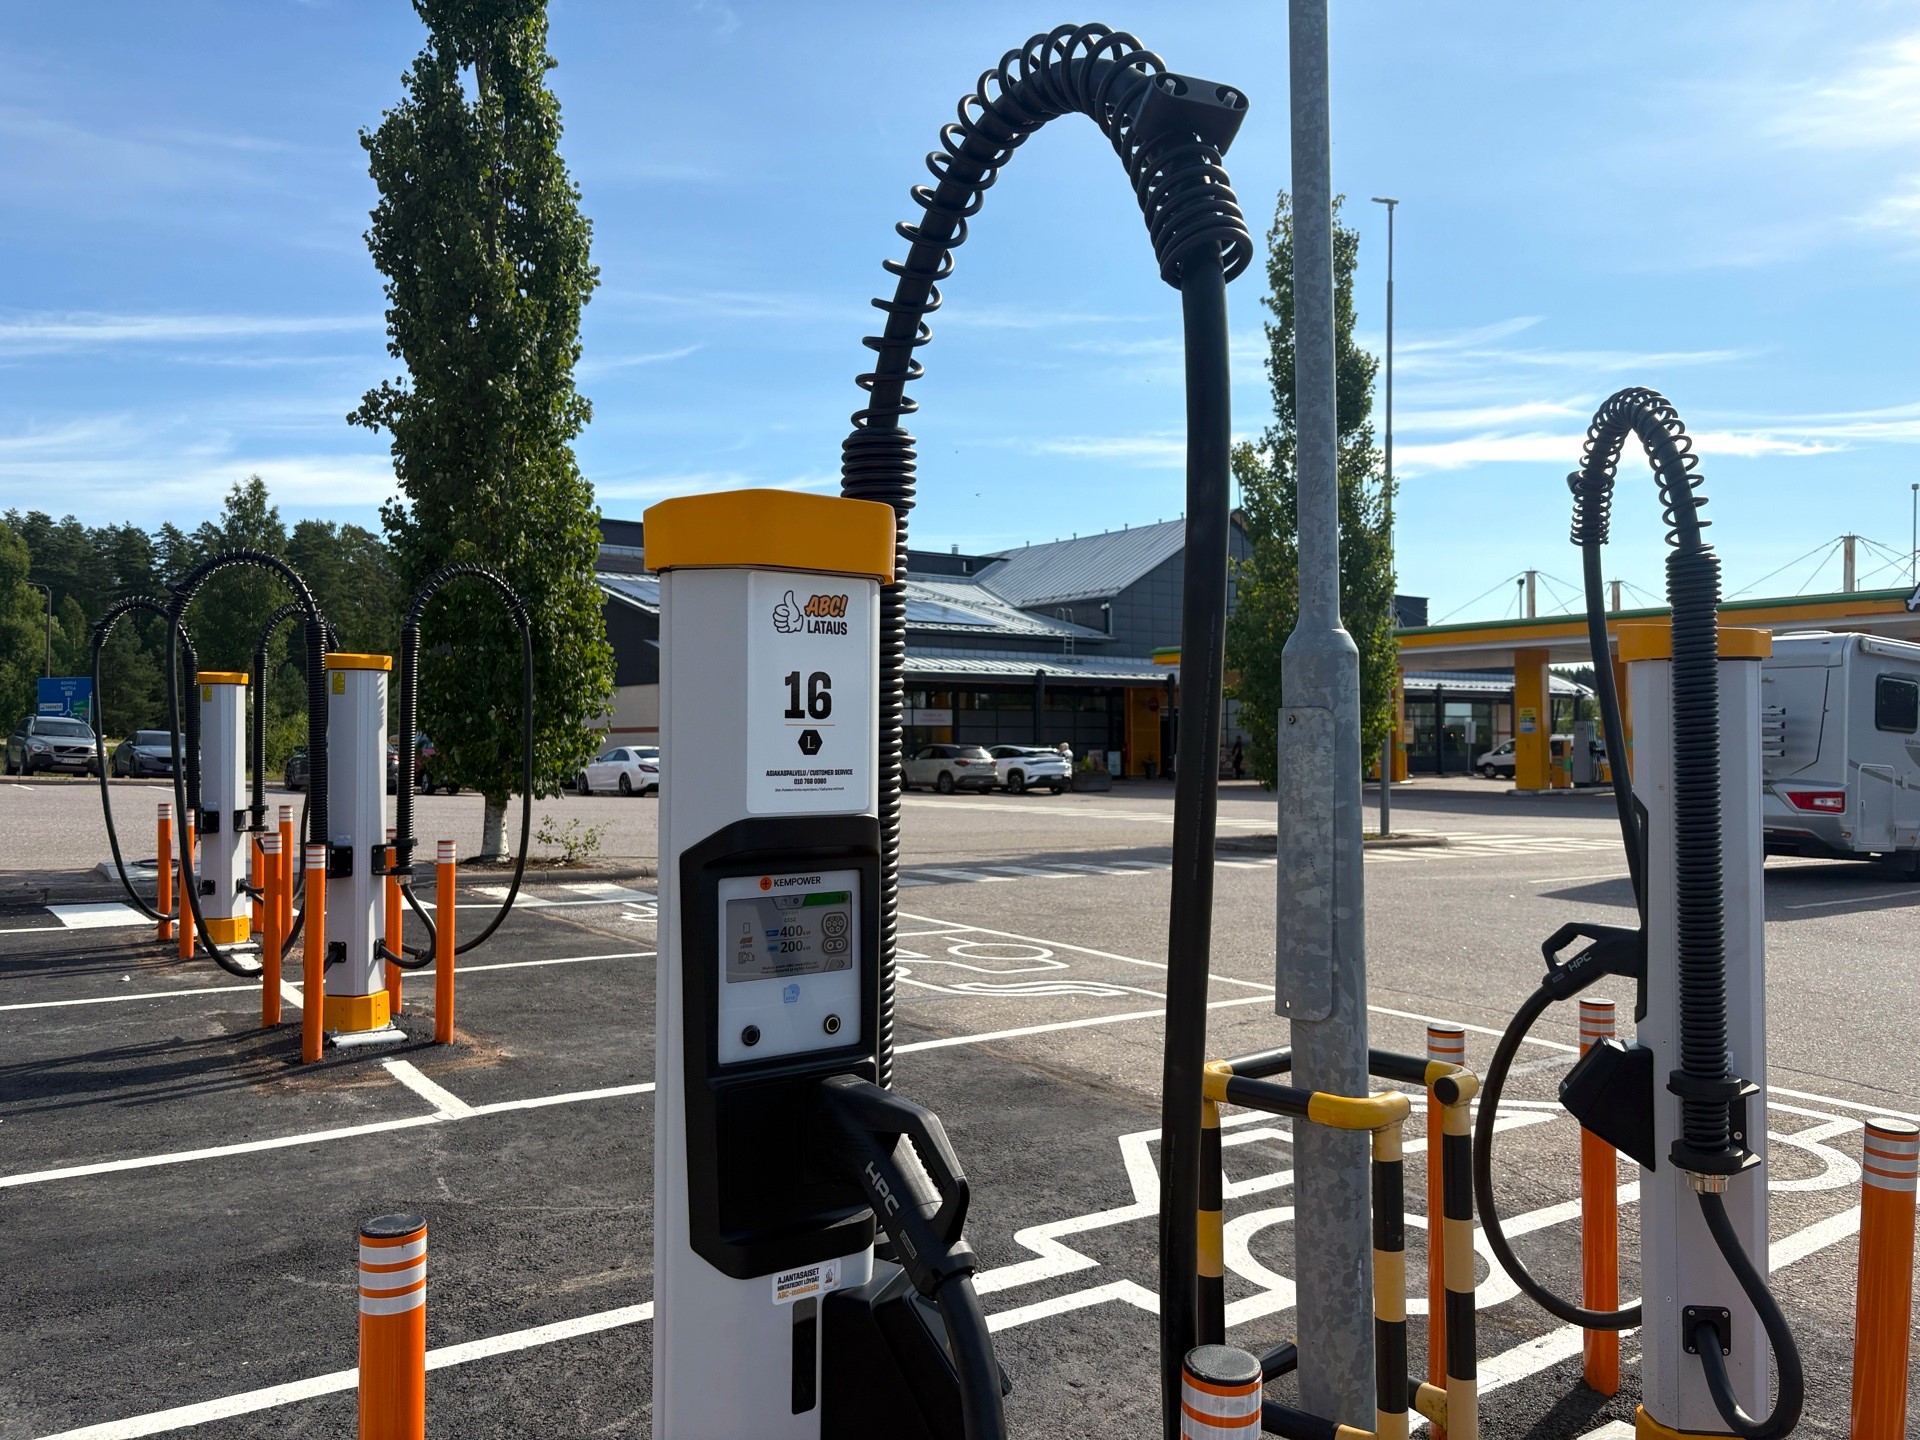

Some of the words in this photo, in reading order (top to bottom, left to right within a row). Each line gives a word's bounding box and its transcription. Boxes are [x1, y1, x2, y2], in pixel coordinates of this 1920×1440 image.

[804, 594, 848, 618] ABC!
[807, 620, 847, 635] LATAUS
[785, 671, 832, 720] 16
[807, 735, 816, 749] L
[810, 769, 834, 777] CUSTOMER
[773, 876, 821, 887] KEMPOWER
[780, 925, 803, 938] 400
[780, 940, 803, 953] 200
[1567, 951, 1593, 972] HPC
[865, 1161, 900, 1217] HPC
[777, 1267, 820, 1285] AJANTASAISET
